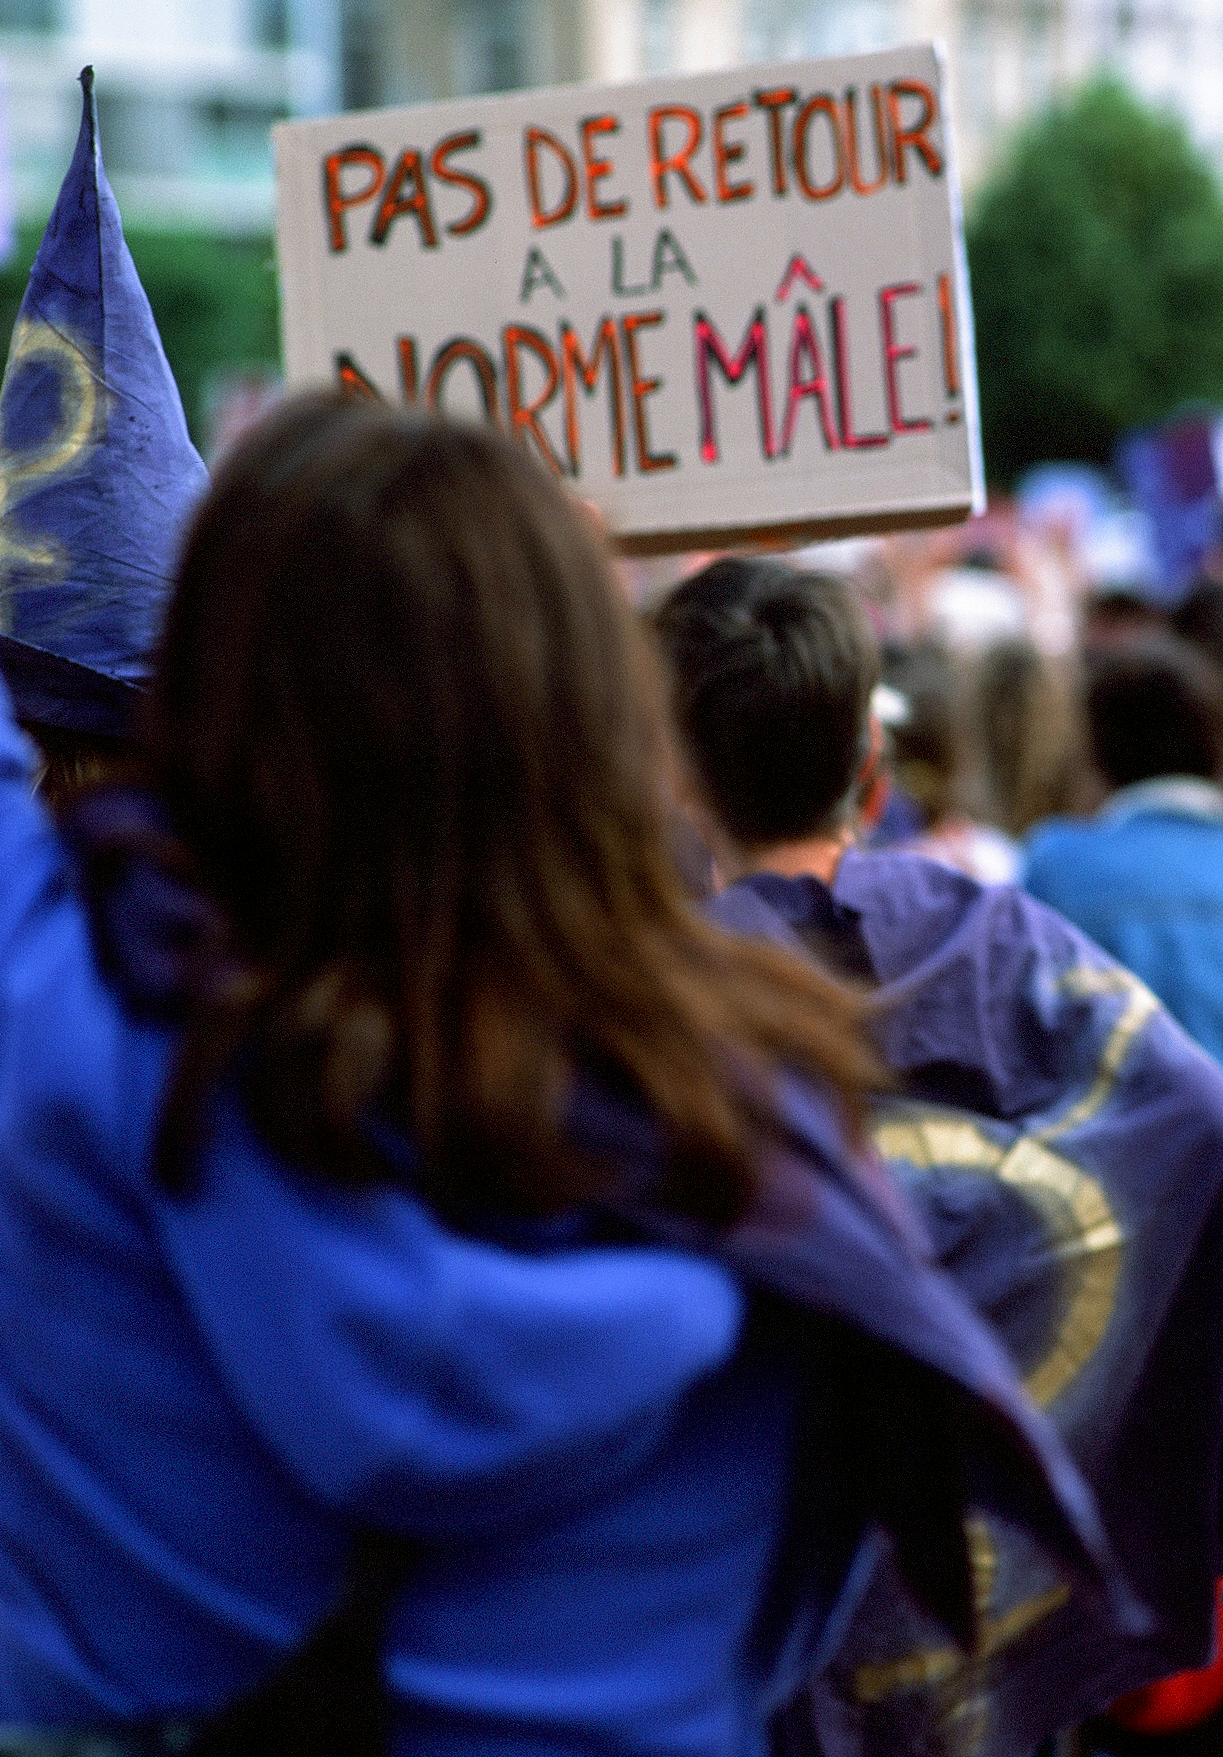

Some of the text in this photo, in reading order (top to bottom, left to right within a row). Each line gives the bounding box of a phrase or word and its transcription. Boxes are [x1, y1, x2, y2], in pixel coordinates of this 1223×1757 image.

[324, 78, 944, 251] PAS DE RETOUR
[521, 228, 698, 302] A LA
[694, 254, 961, 463] MÂLE!
